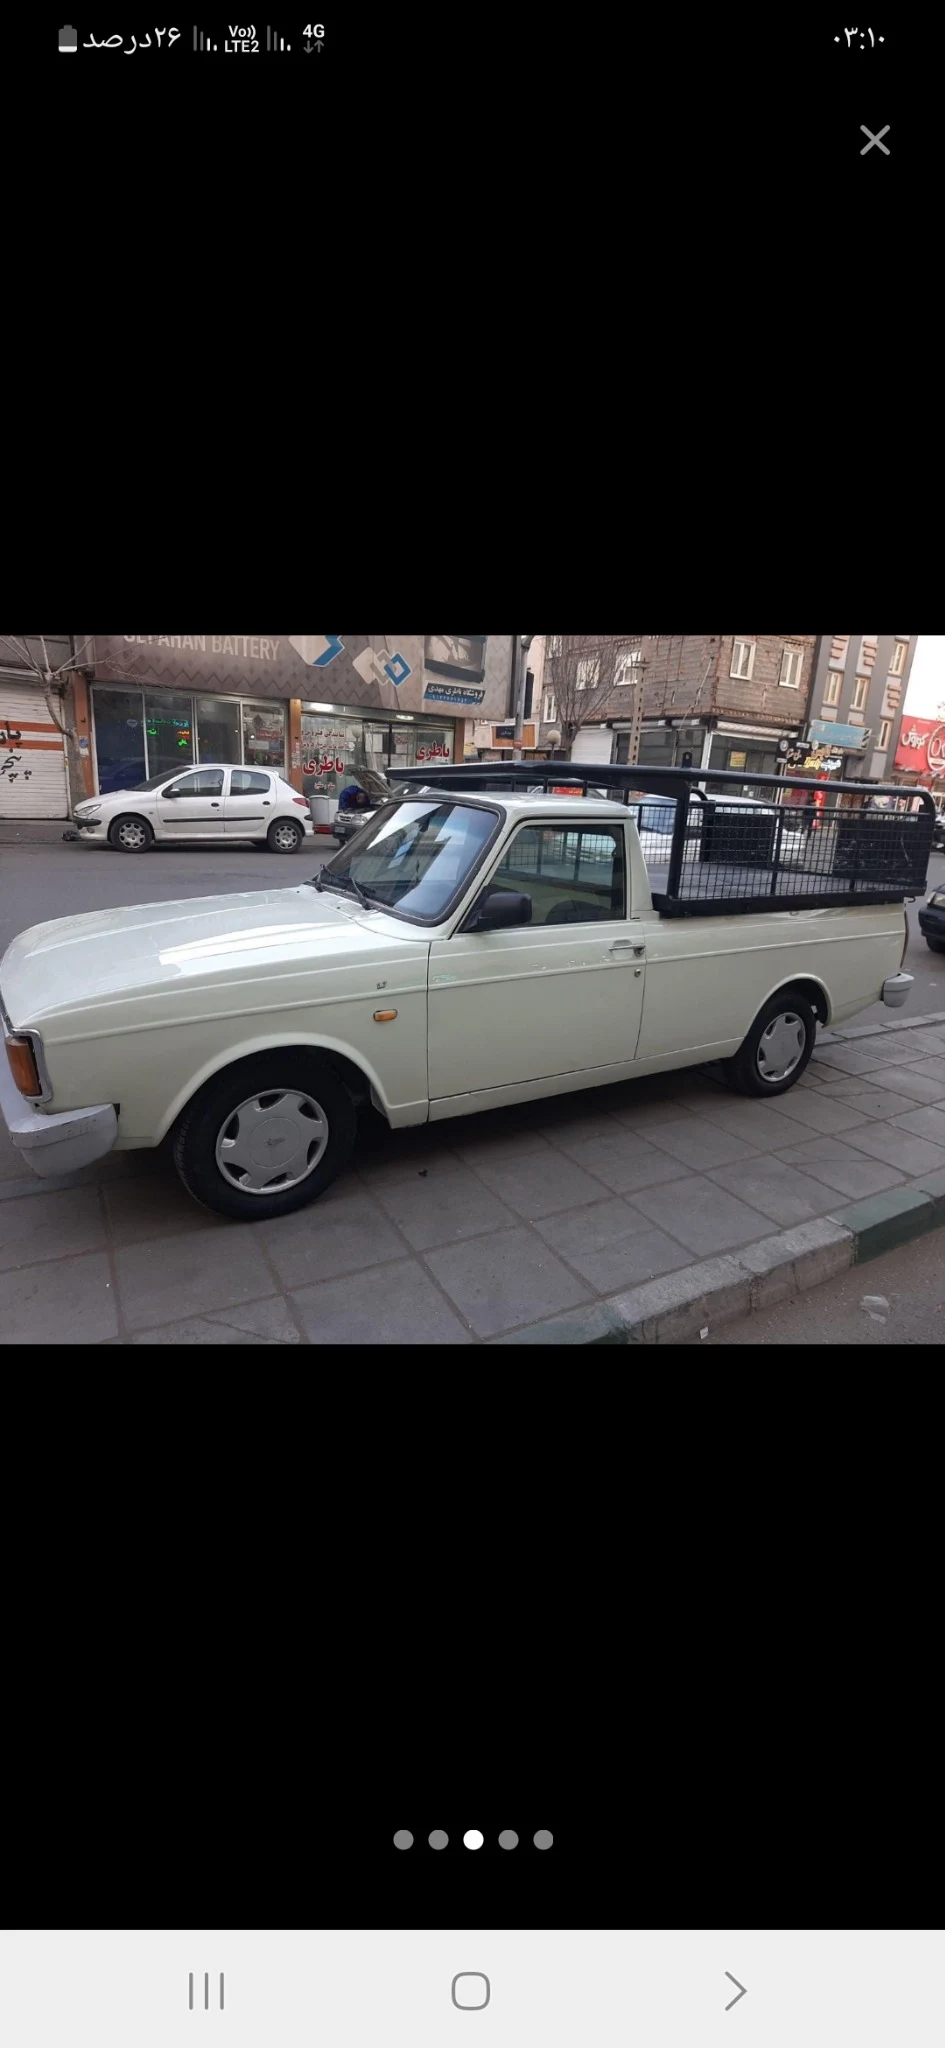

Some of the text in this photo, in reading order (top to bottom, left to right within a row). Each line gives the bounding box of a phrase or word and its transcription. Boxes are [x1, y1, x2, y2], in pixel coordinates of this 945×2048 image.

[212, 636, 280, 660] BATTERY
[427, 685, 444, 694] مهدی
[445, 687, 462, 697] باطری
[462, 689, 483, 701] فروشگاه
[901, 723, 930, 750] کوروش
[415, 741, 450, 762] باطری
[302, 754, 345, 777] باطری
